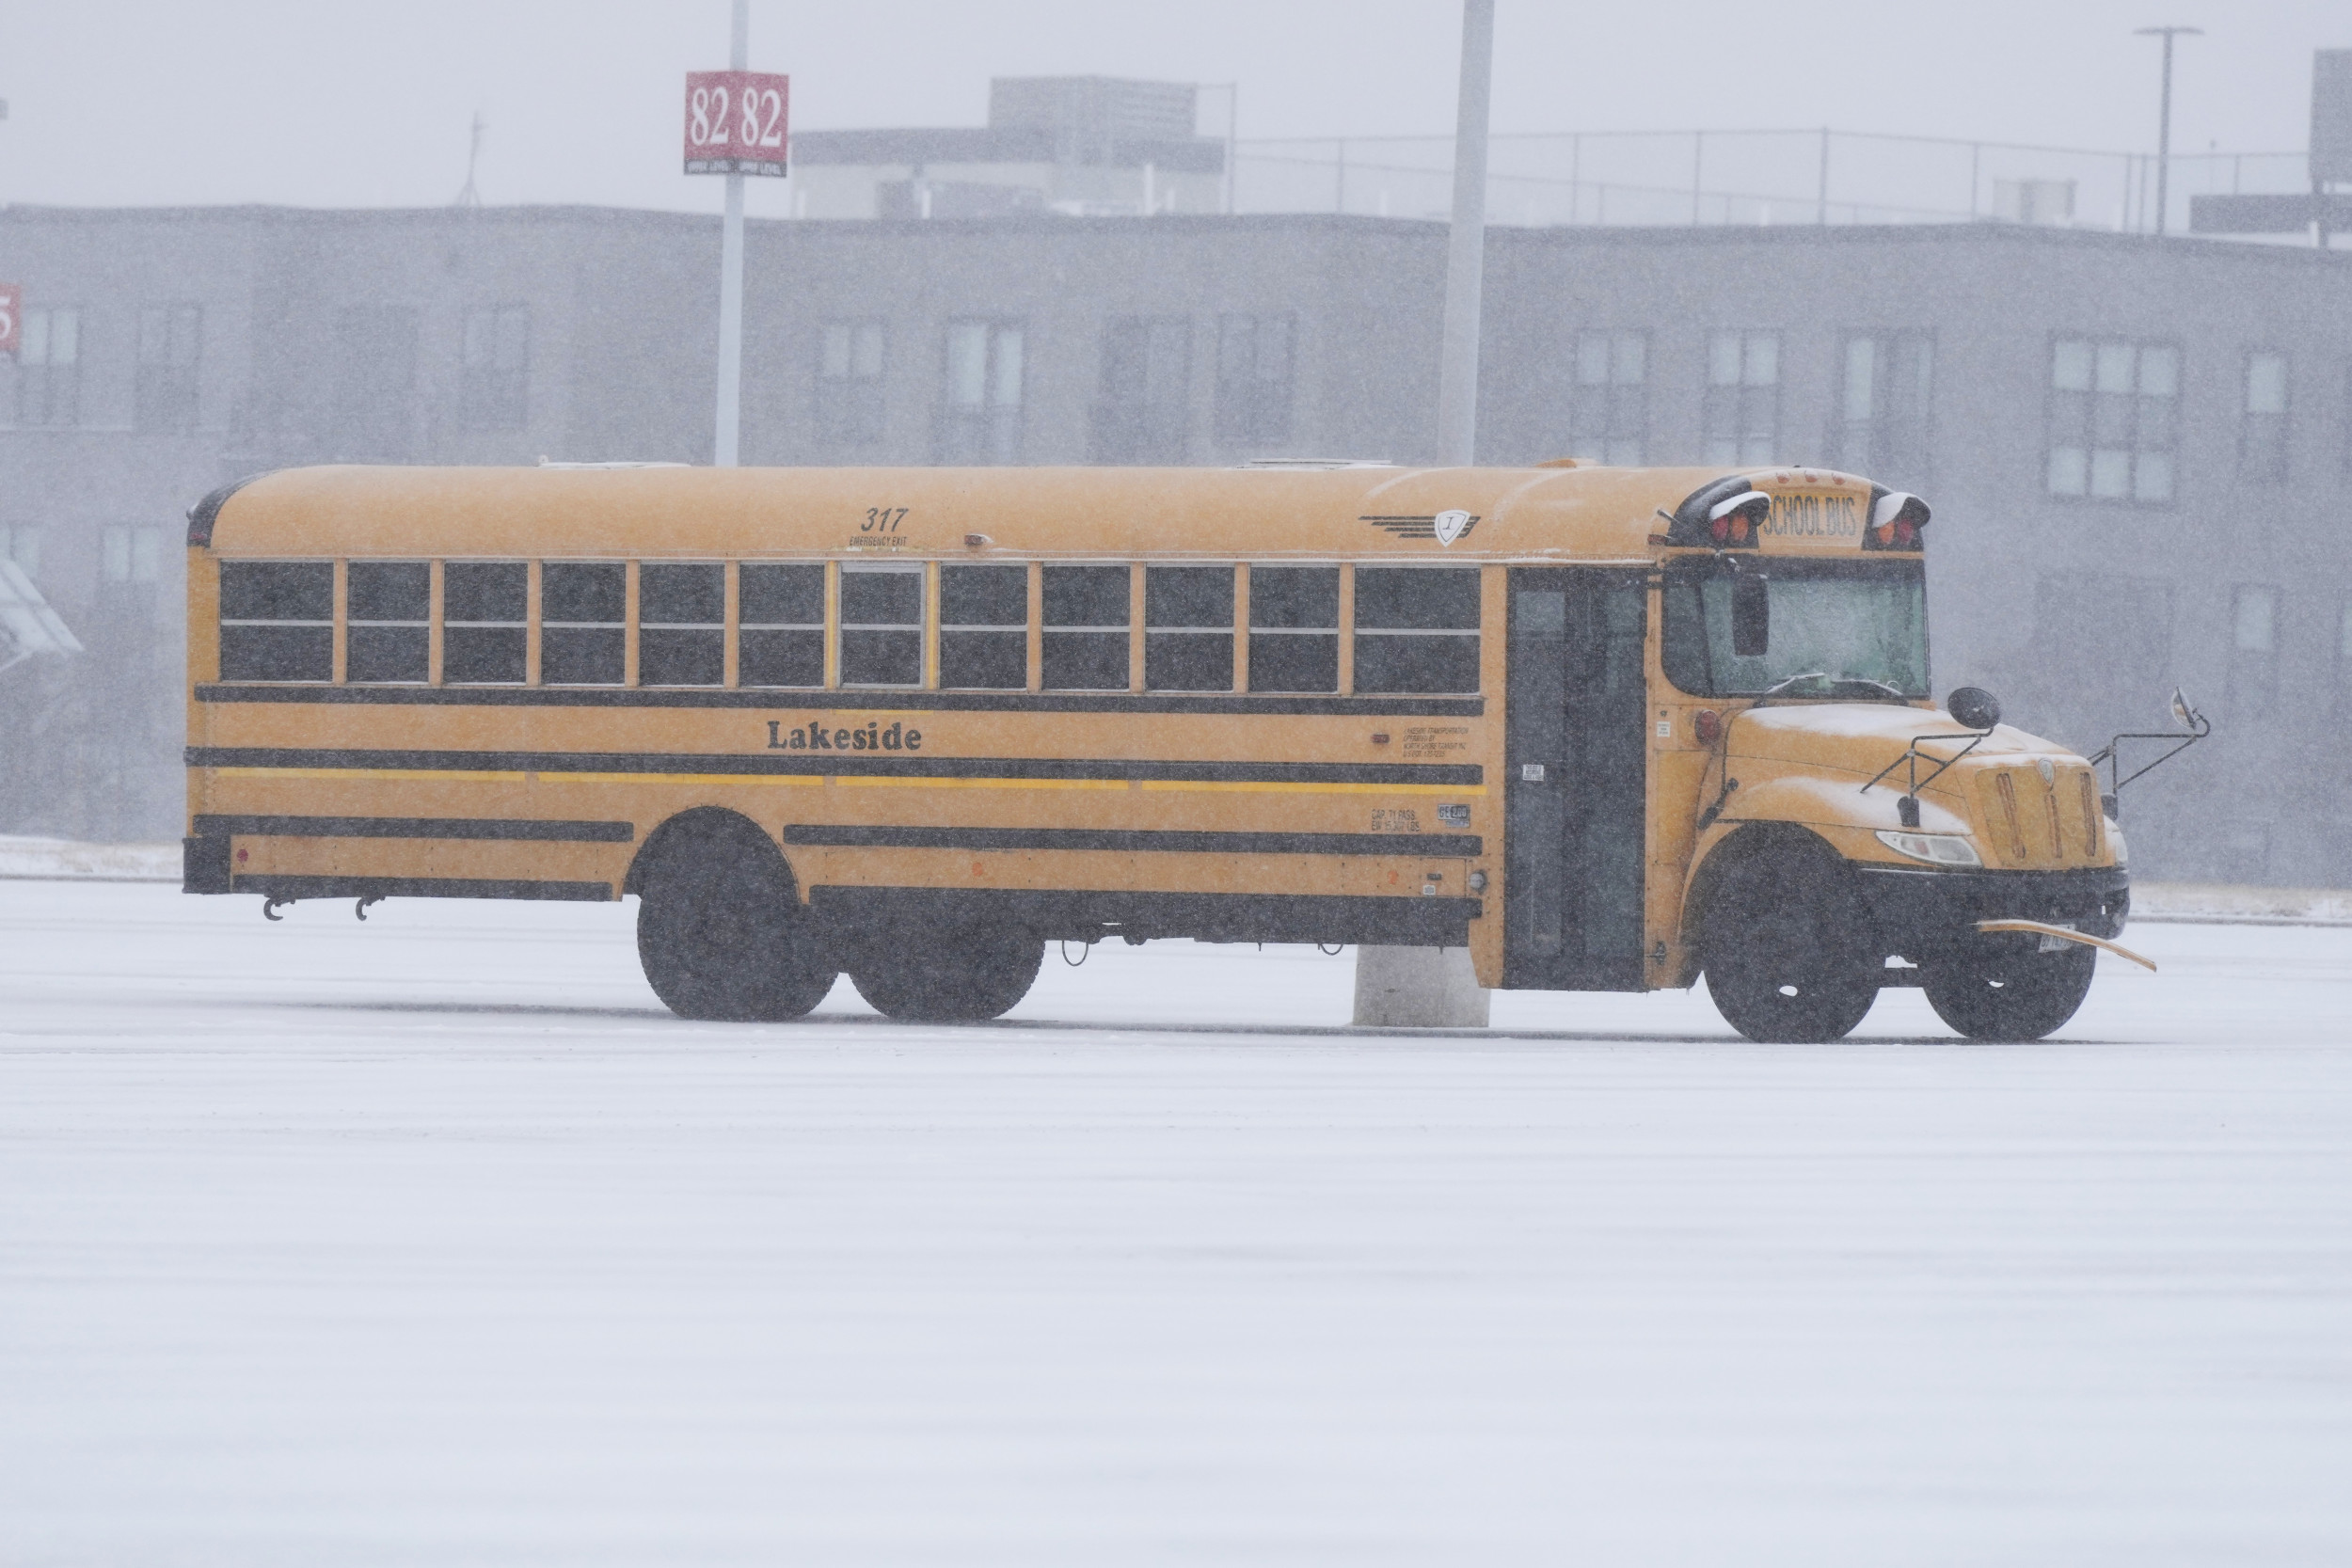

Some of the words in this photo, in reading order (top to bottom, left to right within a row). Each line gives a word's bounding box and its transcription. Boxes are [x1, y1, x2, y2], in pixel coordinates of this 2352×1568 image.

[691, 87, 729, 146] 82
[741, 87, 782, 148] 82
[861, 507, 910, 532] 317
[1825, 496, 1857, 536] BUS
[850, 536, 891, 546] EMERGENCY
[892, 536, 907, 546] EXIT
[767, 721, 922, 751] Lakeside
